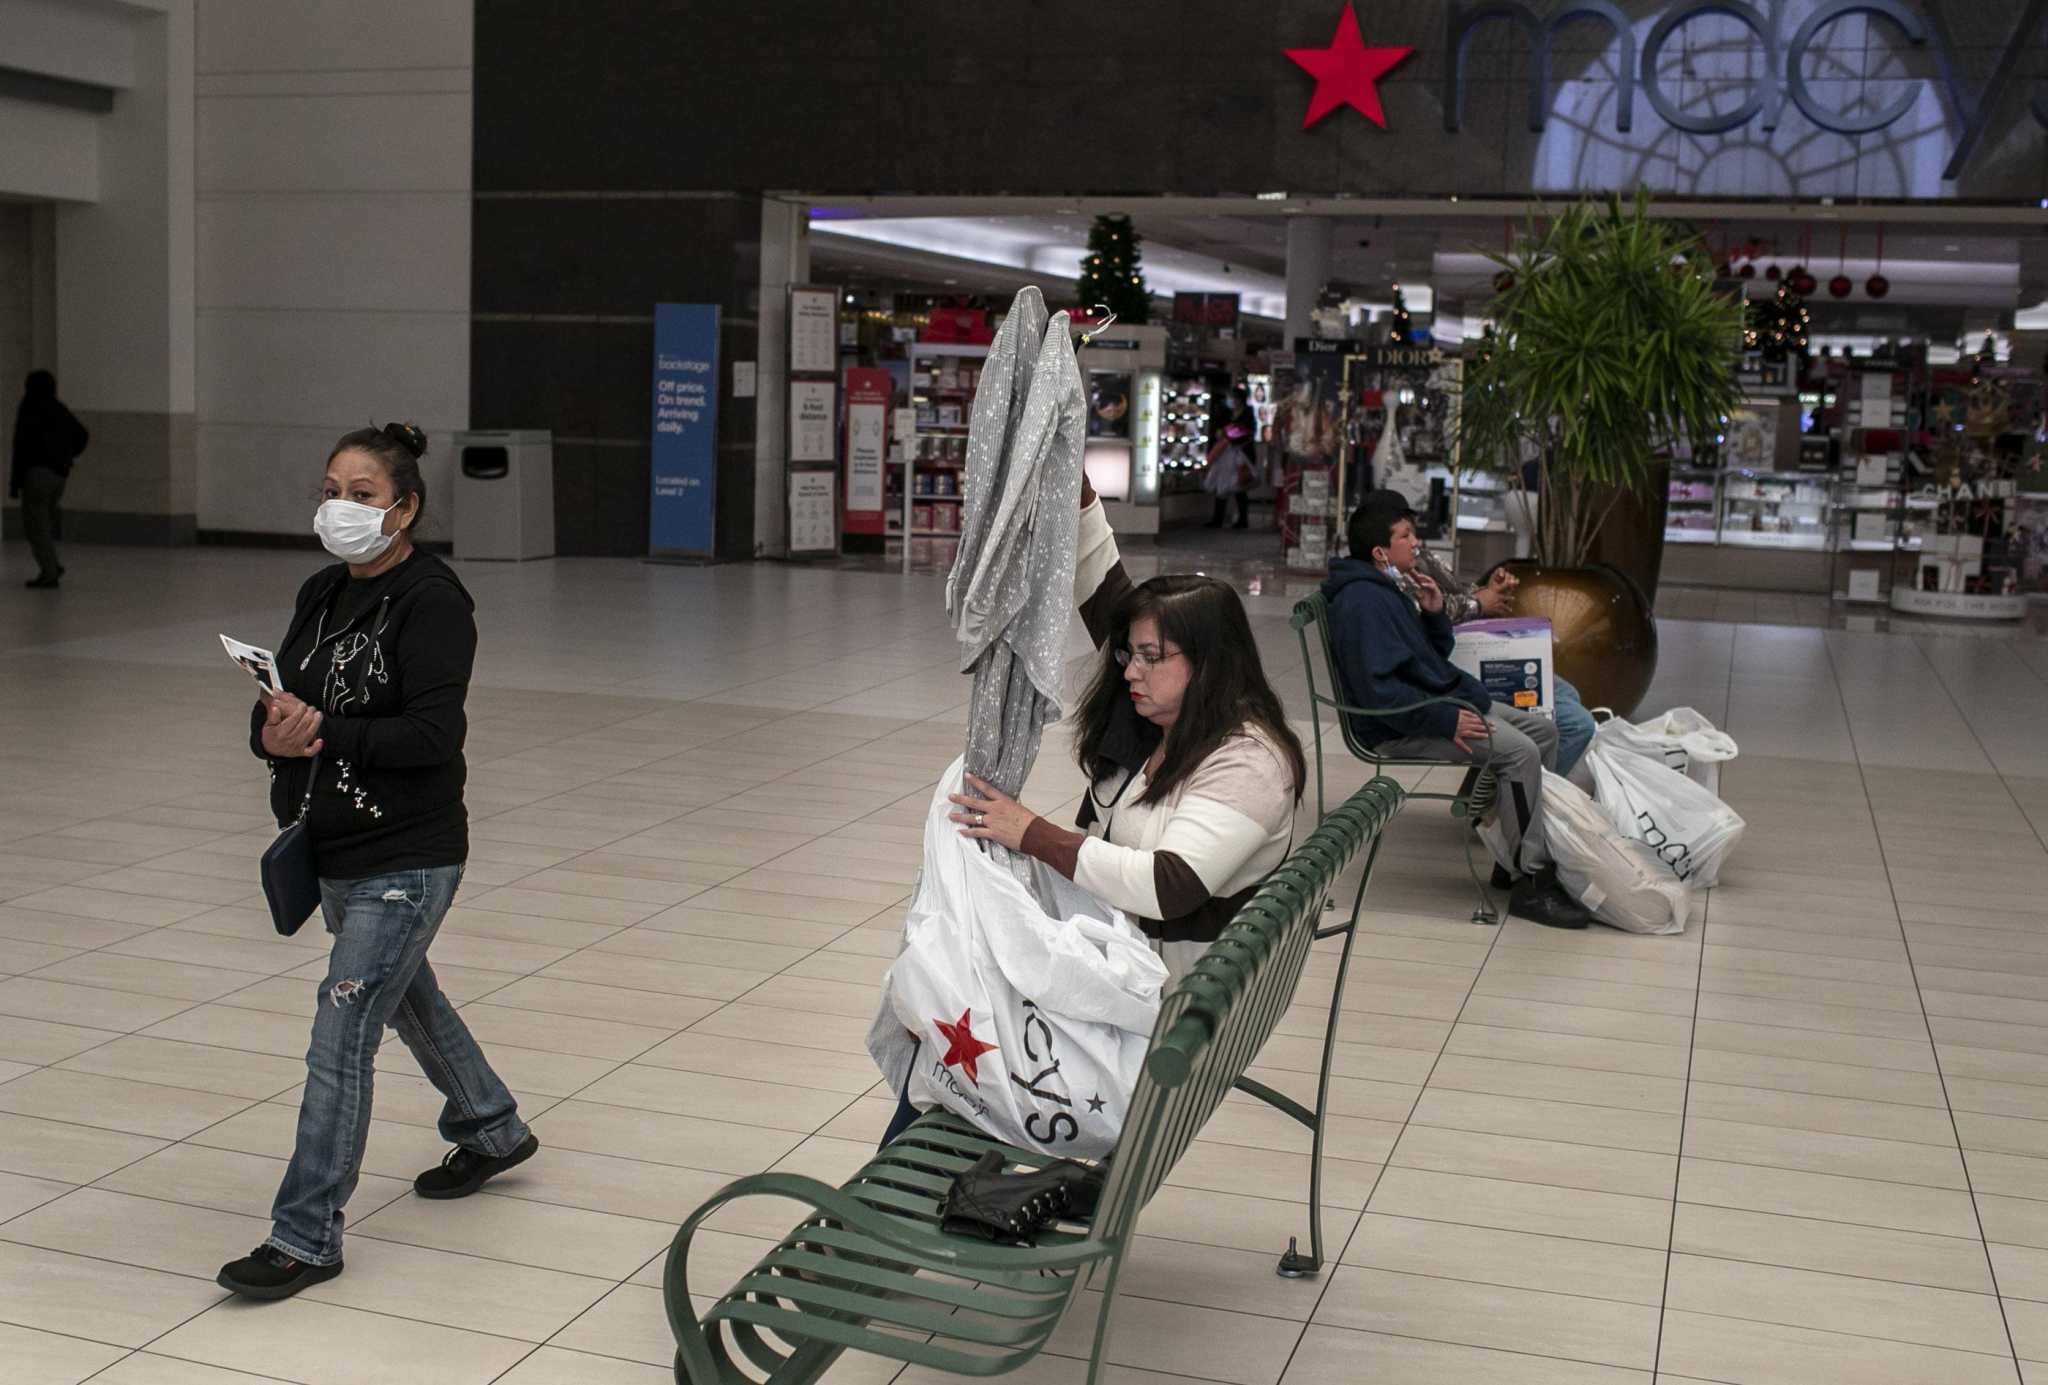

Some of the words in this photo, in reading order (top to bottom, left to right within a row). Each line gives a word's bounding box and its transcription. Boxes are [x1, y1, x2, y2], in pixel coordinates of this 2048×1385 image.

[1444, 0, 2048, 180] macy
[1377, 348, 1430, 365] DIOR
[658, 355, 710, 373] backstage
[658, 380, 676, 393] Off
[657, 394, 674, 405] On
[657, 408, 699, 422] Arriving
[655, 486, 677, 496] Level
